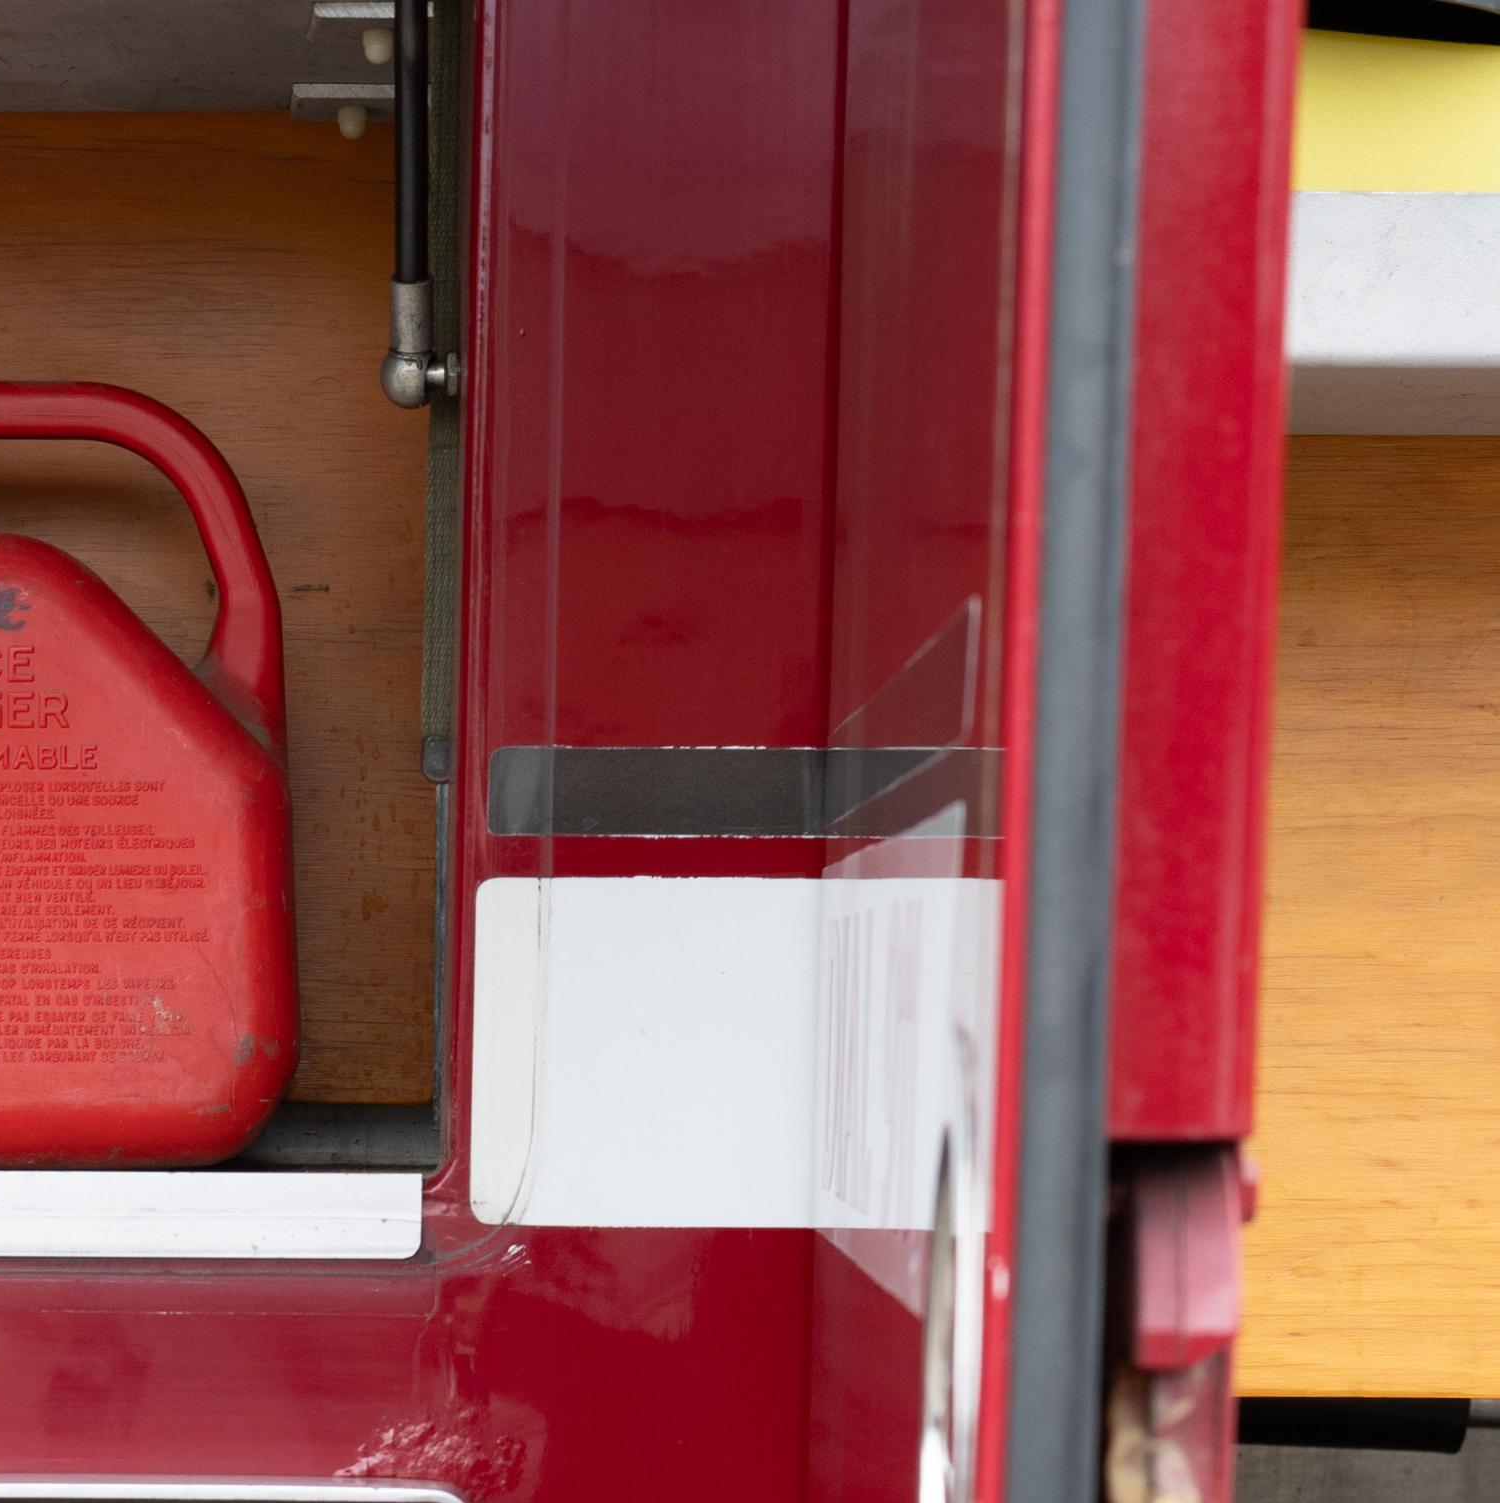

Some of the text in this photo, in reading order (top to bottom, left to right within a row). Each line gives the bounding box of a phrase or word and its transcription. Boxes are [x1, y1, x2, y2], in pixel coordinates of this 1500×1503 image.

[134, 782, 165, 793] SONT
[49, 795, 63, 807] OU
[67, 795, 90, 807] UNE
[92, 795, 139, 807] SOURCE
[59, 825, 80, 837] DES
[36, 839, 56, 850] DES
[60, 839, 113, 850] MOTEURS
[53, 865, 65, 877] ET
[76, 879, 93, 890] OU
[97, 879, 112, 890] UN
[117, 879, 142, 890] LIEU
[16, 892, 42, 903] BIEN
[83, 919, 99, 930] DE
[103, 919, 118, 930] CE
[139, 932, 161, 943] PAS
[96, 979, 118, 990] LES
[35, 995, 50, 1006] EN
[56, 995, 78, 1006] CAS
[10, 1012, 30, 1023] PAS
[47, 1039, 68, 1050] PAR
[75, 1039, 89, 1050] LA
[3, 1051, 24, 1063] LES
